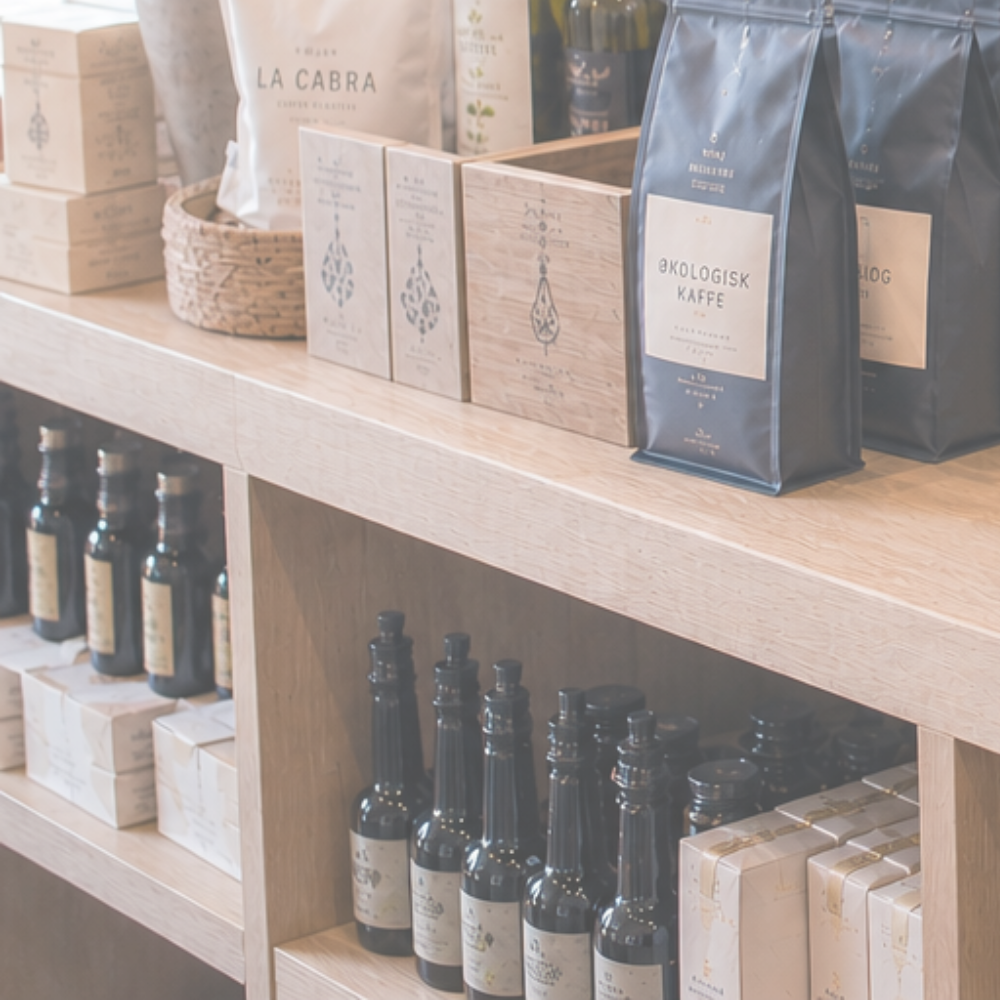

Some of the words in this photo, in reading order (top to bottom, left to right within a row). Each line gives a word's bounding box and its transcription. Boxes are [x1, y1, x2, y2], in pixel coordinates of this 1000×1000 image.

[257, 66, 284, 90] LA
[295, 67, 377, 94] CABRA
[658, 257, 750, 290] ØKOLOGISK
[677, 285, 725, 310] KAFFE
